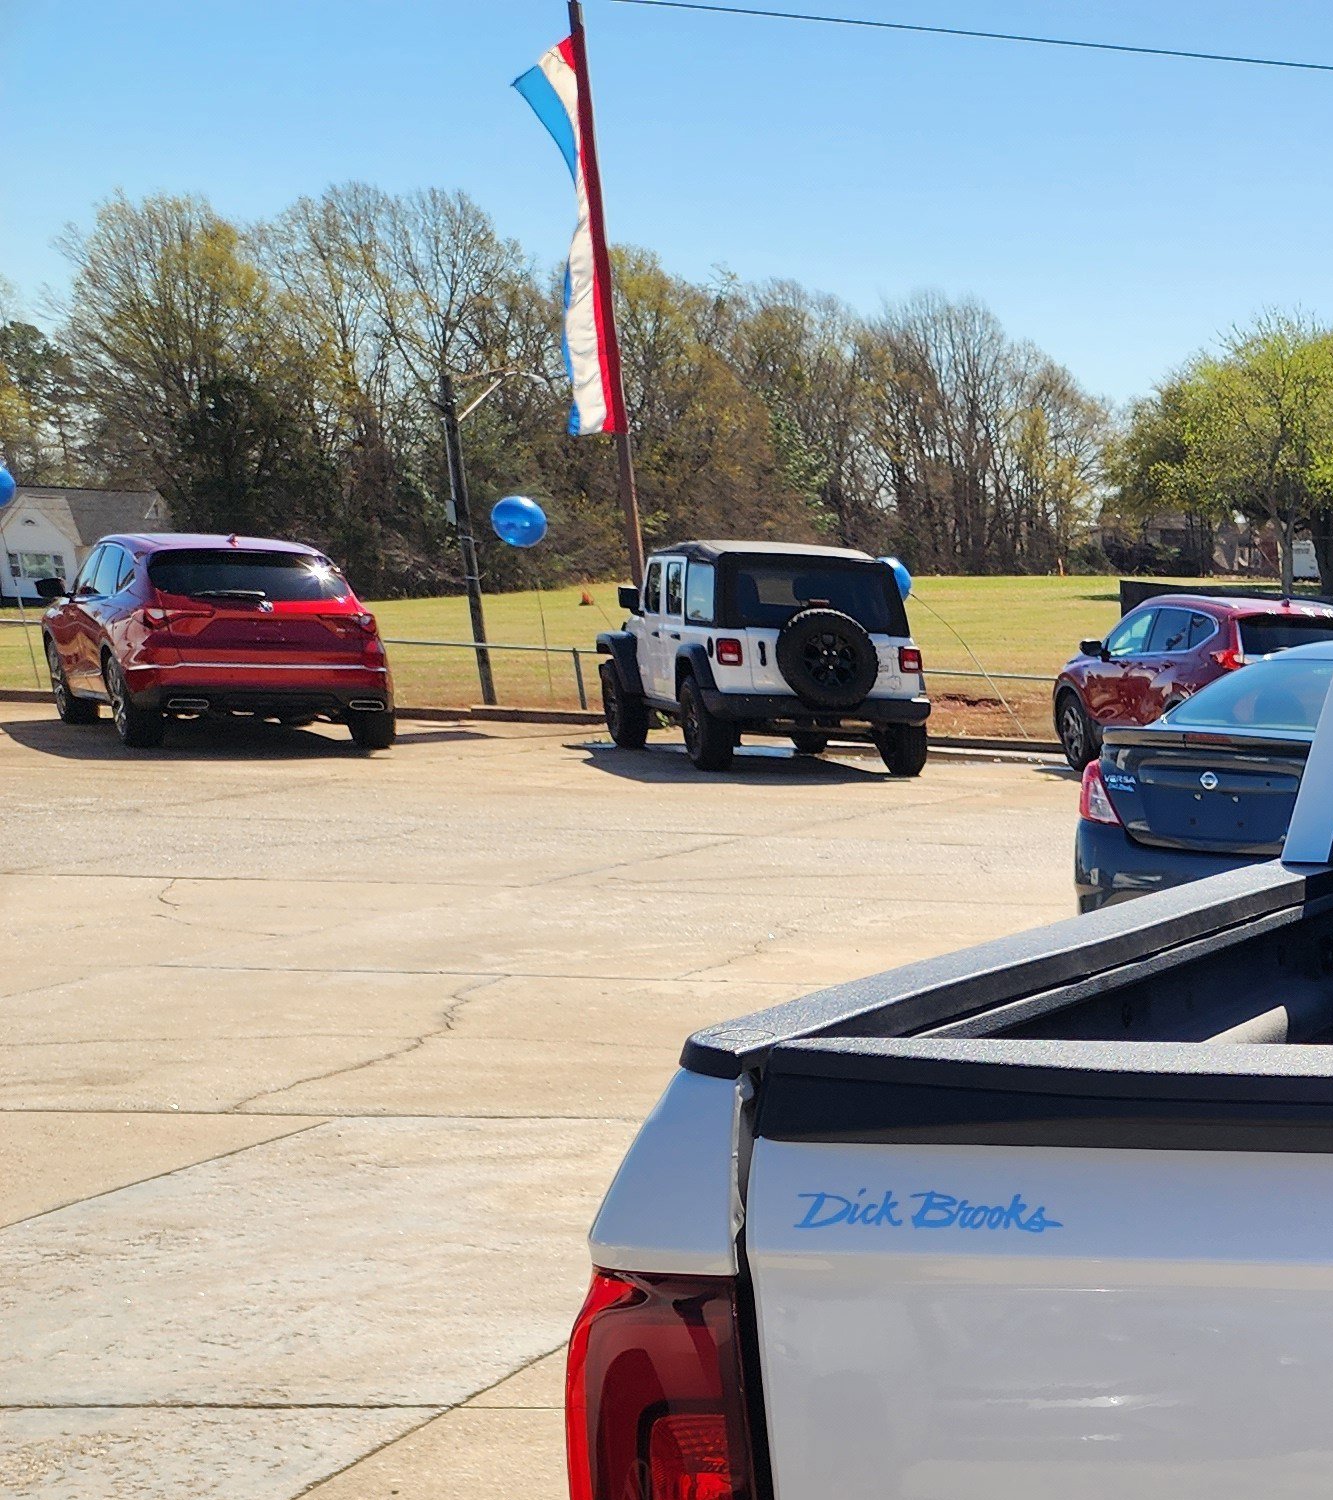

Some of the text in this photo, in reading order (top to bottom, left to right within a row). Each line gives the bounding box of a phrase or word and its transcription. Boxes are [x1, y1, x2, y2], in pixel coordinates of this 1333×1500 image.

[1104, 774, 1136, 784] VERSA
[794, 1188, 1063, 1233] Dick Brooks
